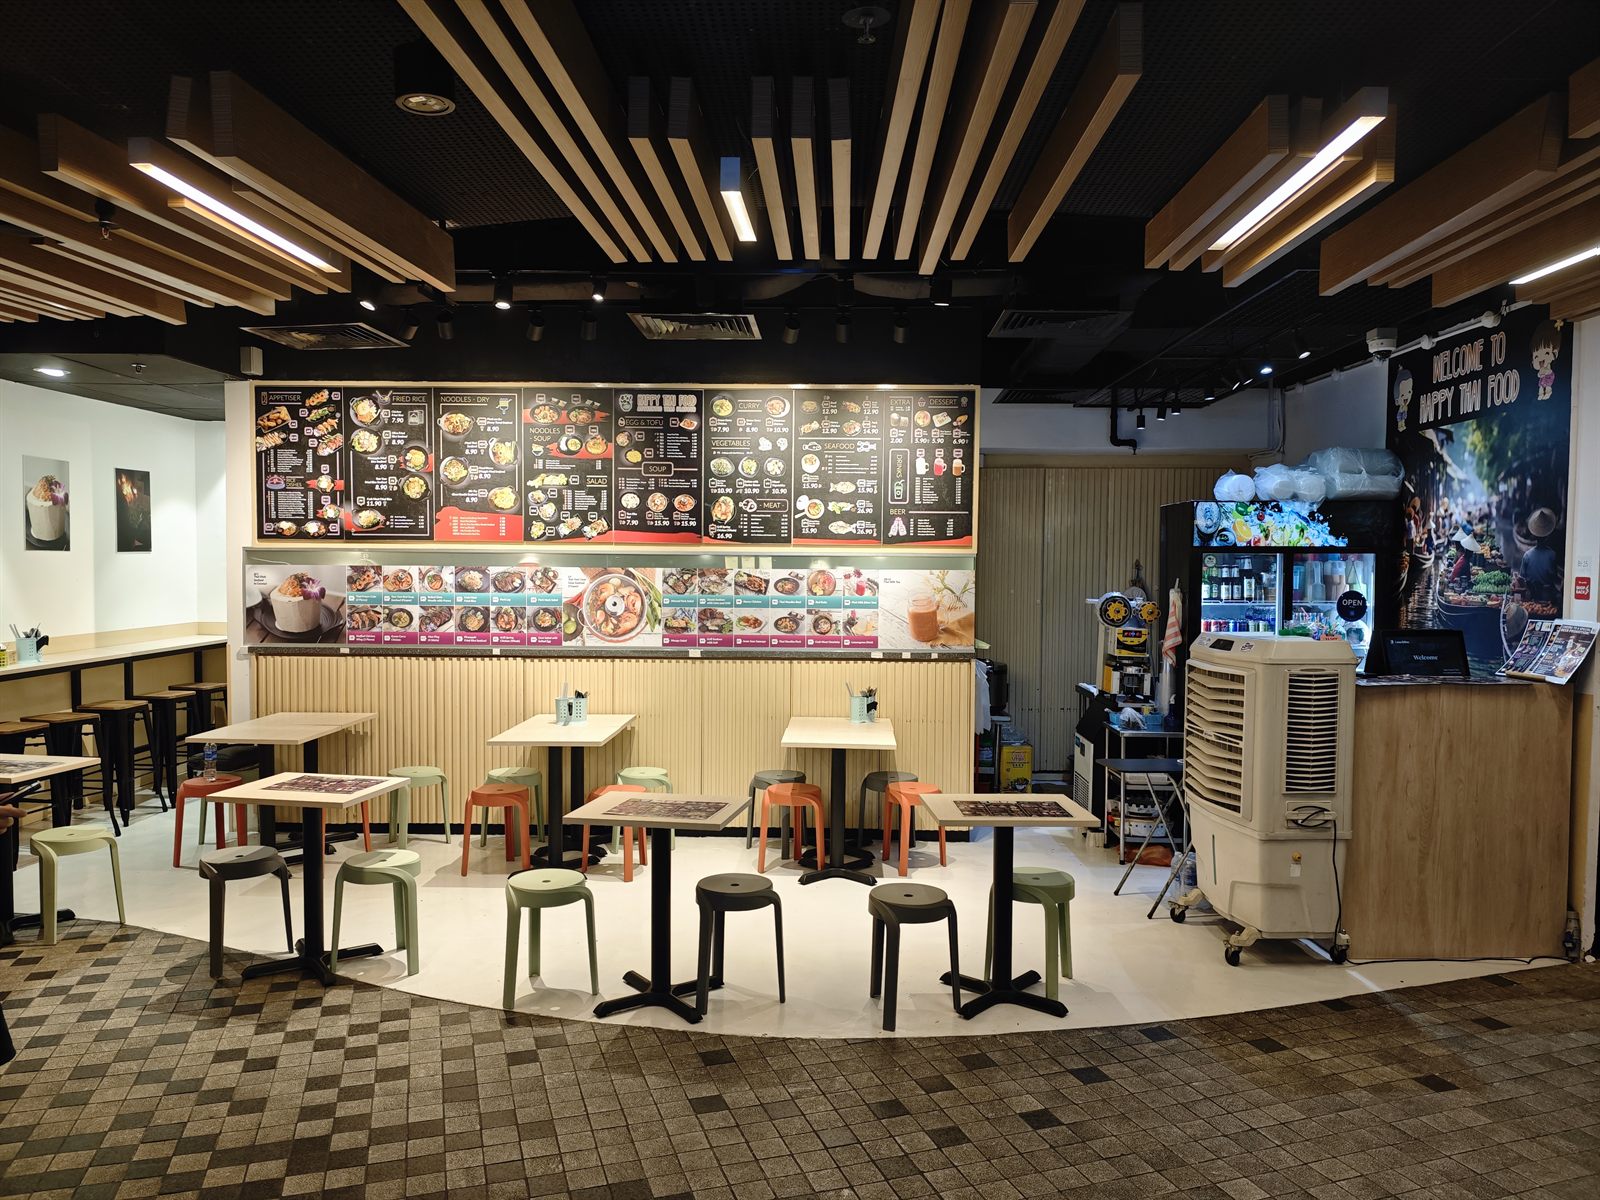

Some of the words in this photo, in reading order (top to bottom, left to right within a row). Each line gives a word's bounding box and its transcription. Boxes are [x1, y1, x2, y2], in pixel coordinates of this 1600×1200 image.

[1432, 338, 1484, 384] WELCOME
[1490, 331, 1506, 367] TO
[1419, 386, 1454, 425] HAPPY
[1459, 379, 1482, 415] THAI
[1487, 369, 1520, 408] FOOD
[1342, 599, 1363, 607] OPEN
